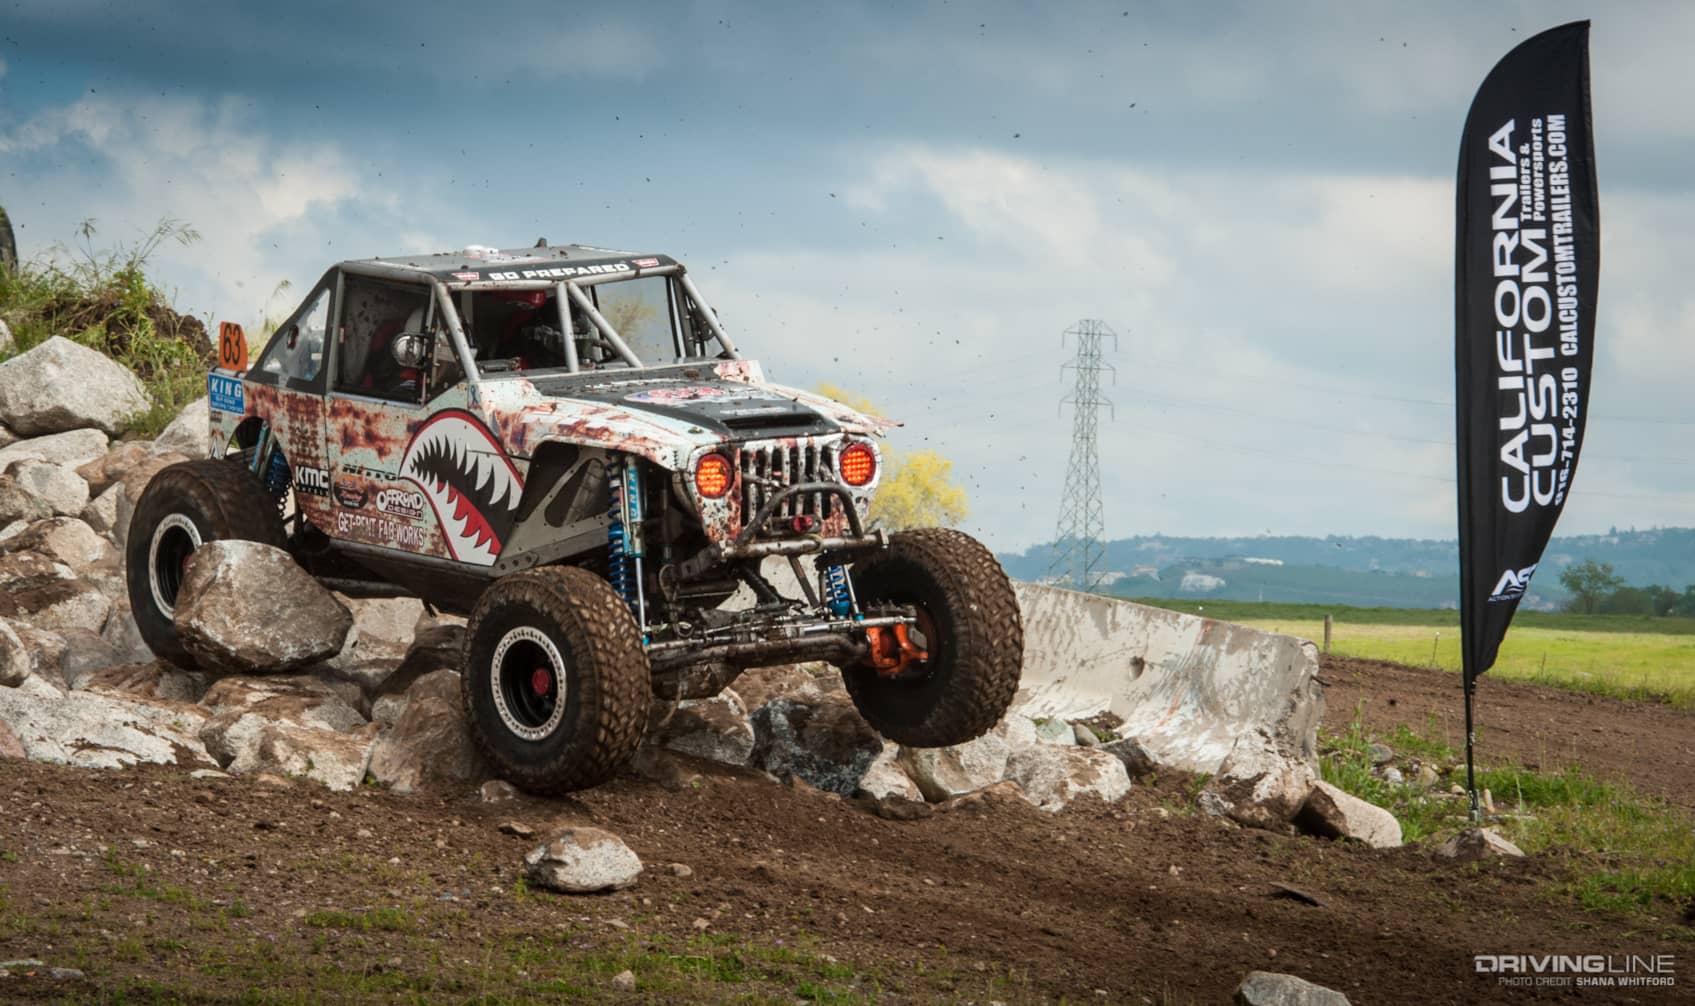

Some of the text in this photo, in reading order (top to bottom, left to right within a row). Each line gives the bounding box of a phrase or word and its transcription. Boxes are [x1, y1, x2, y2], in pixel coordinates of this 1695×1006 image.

[1520, 143, 1532, 222] Trailers &
[1531, 118, 1546, 222] Powersports
[522, 263, 630, 279] PREPARED
[1488, 118, 1531, 514] CALIFORNIA
[1547, 114, 1580, 506] 916-714-2310 CALCUSTOMTRAILERS.COM
[223, 323, 241, 365] 63
[1520, 229, 1558, 507] CUSTOM
[211, 378, 242, 398] KING
[295, 465, 330, 490] KMC
[396, 523, 425, 546] WORKS
